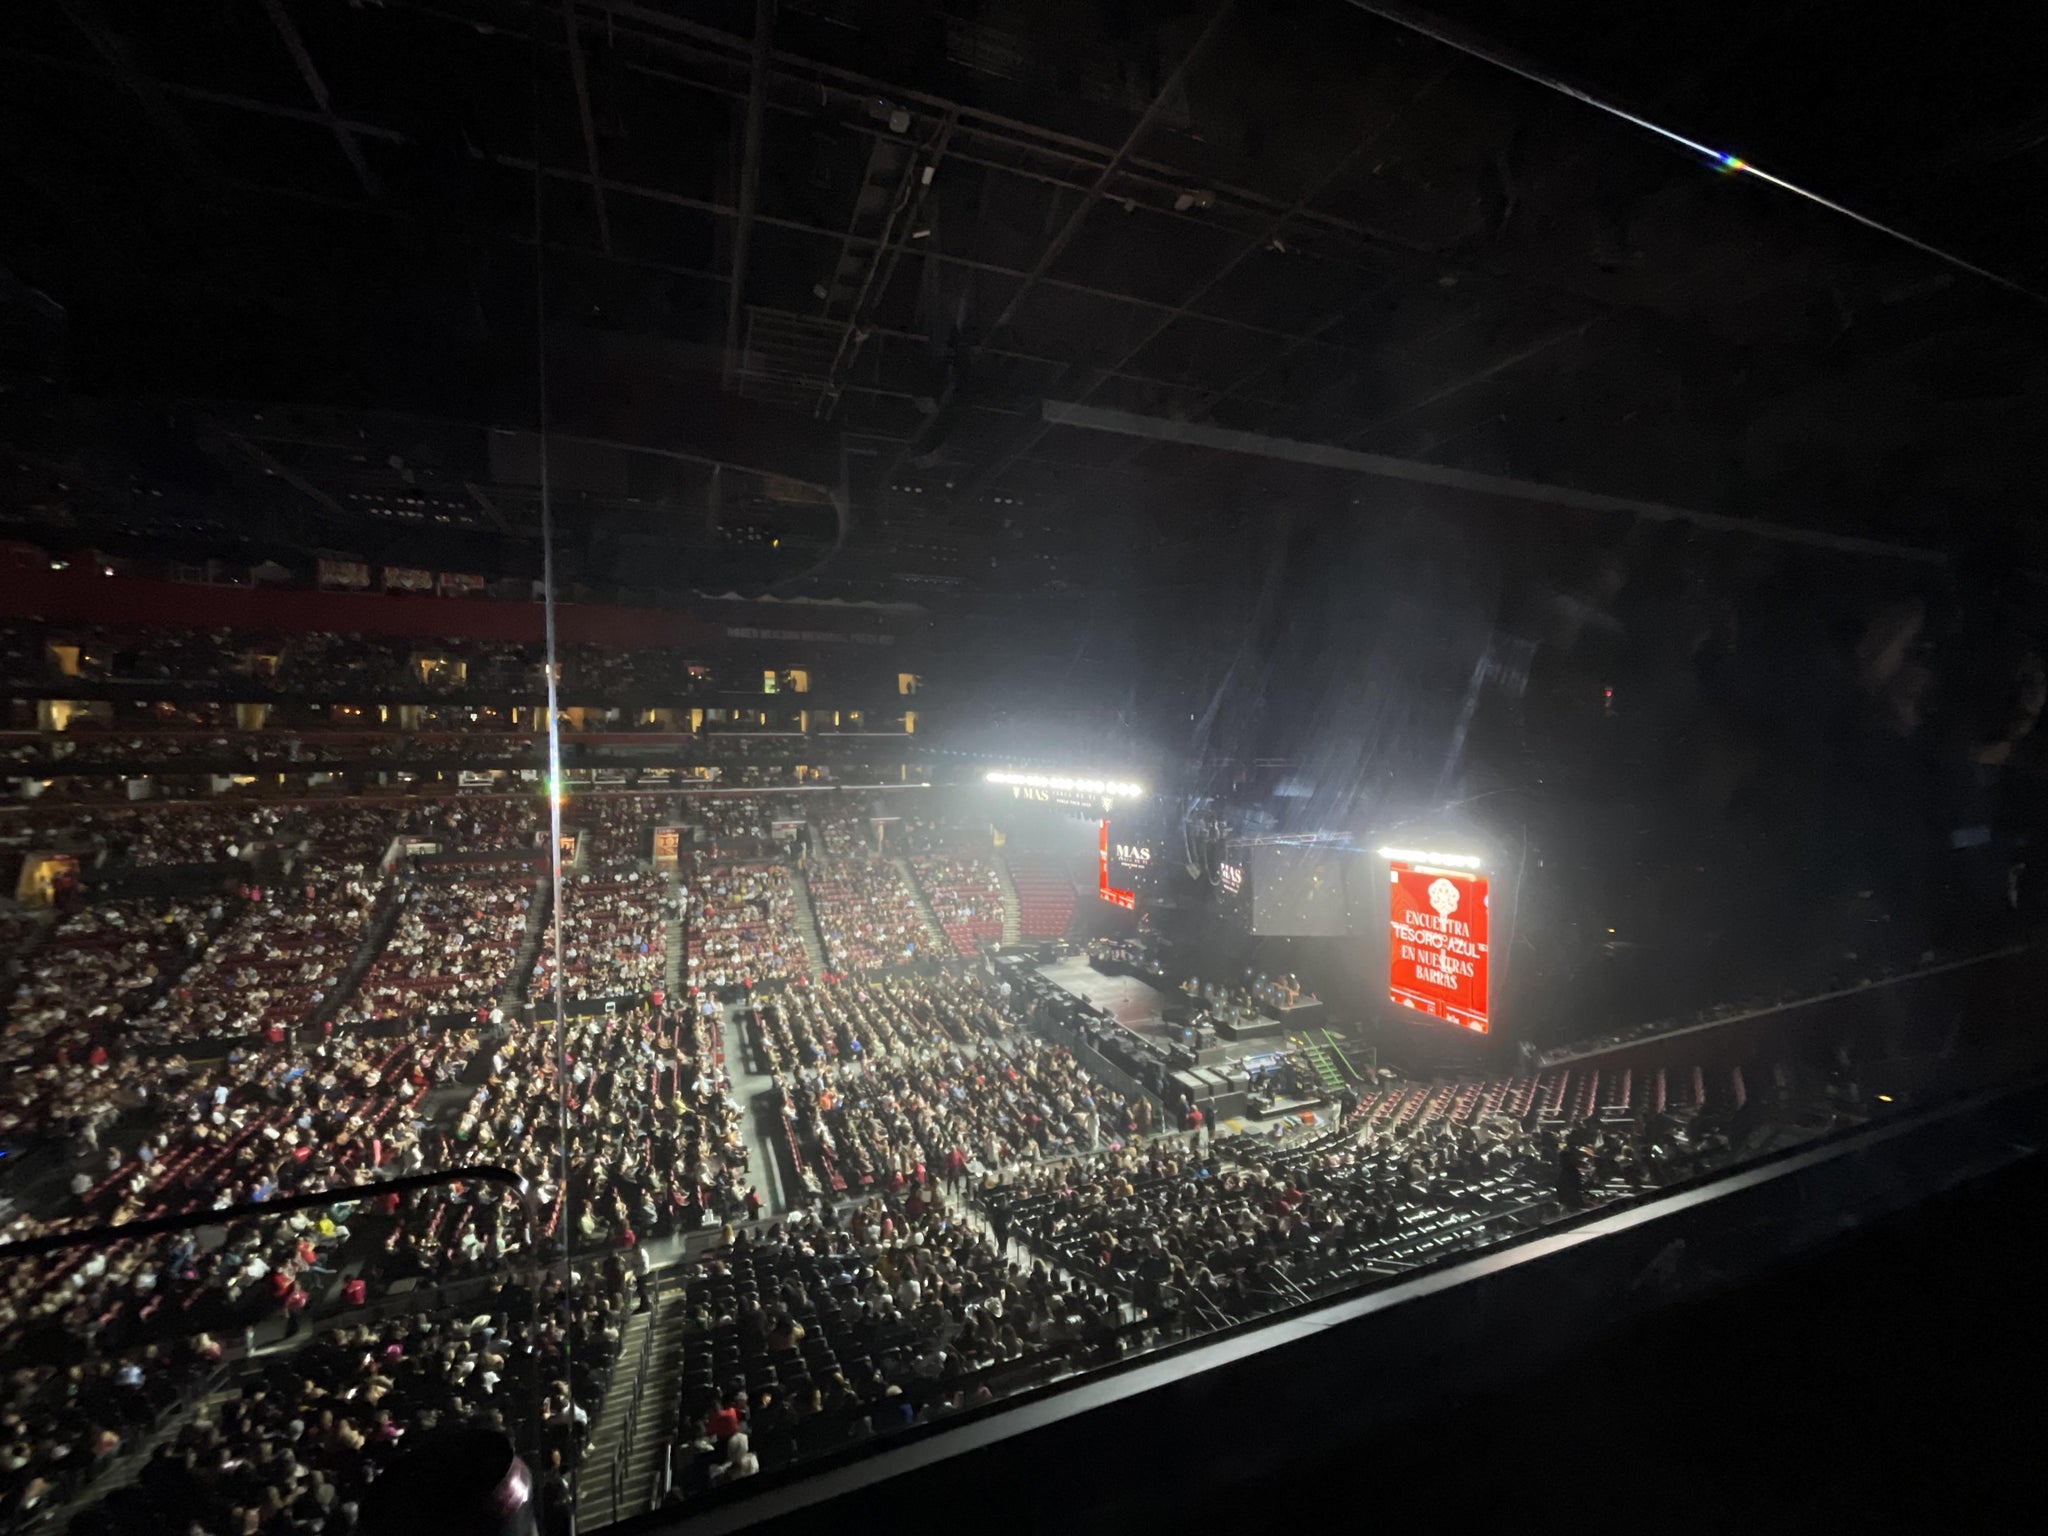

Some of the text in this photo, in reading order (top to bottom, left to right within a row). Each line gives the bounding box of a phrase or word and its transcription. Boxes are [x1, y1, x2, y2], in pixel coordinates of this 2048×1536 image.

[1023, 786, 1049, 801] MAS
[1116, 844, 1151, 860] MAS
[1402, 945, 1415, 960] EN
[1447, 937, 1480, 959] AZUL
[1415, 964, 1458, 990] BARRAS
